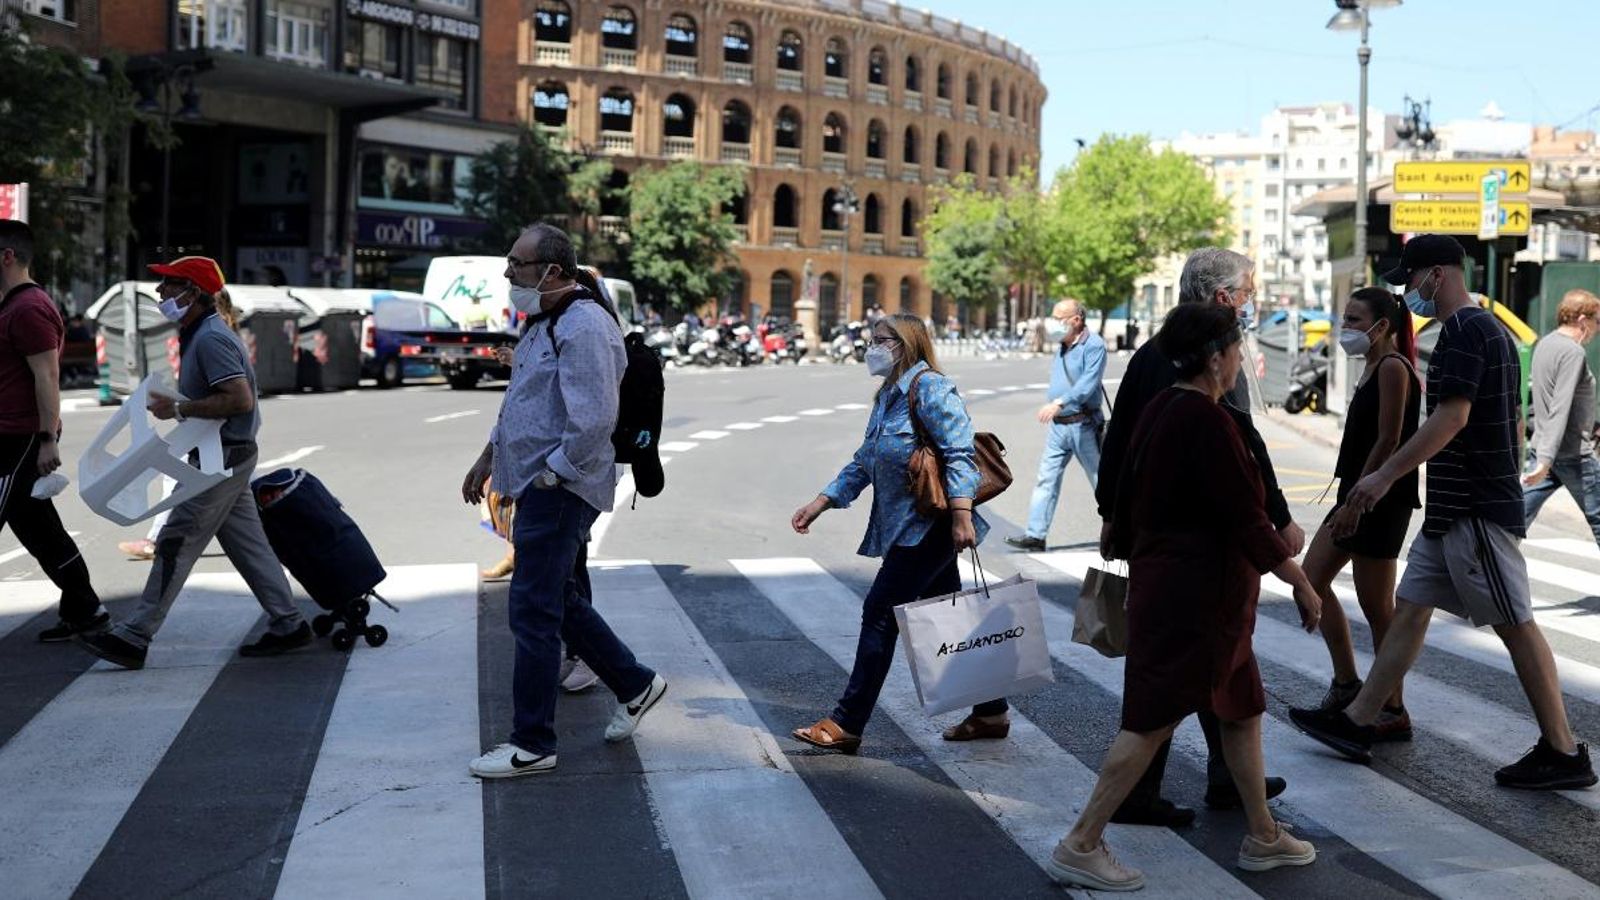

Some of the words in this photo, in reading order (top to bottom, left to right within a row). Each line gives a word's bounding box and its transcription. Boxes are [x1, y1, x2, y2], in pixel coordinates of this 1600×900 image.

[1397, 173, 1426, 182] Sant
[1396, 205, 1433, 214] Centre
[1396, 218, 1433, 227] Mercat
[937, 626, 1025, 657] ALEJANDRO
